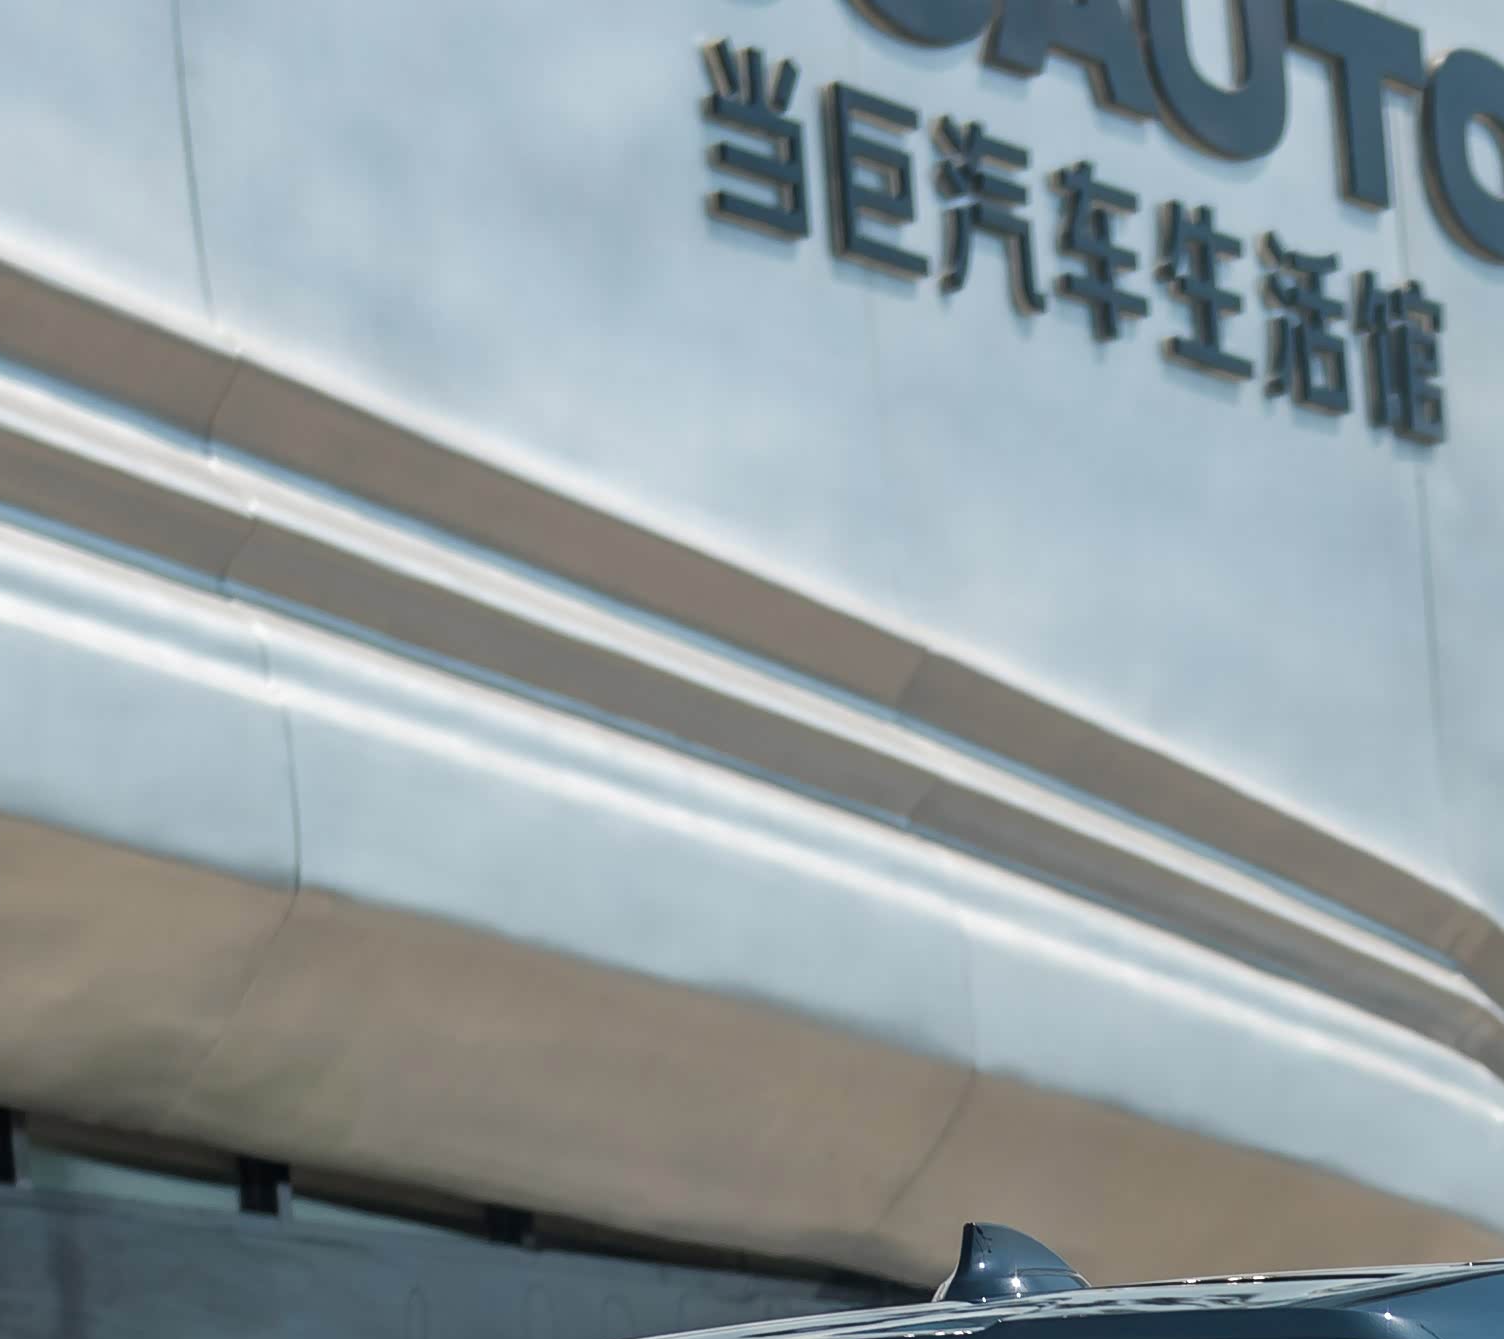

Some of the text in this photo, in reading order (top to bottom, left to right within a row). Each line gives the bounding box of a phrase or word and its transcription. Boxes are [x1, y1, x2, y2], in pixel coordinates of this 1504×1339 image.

[703, 38, 1447, 447] 当巨汽车生活馆
